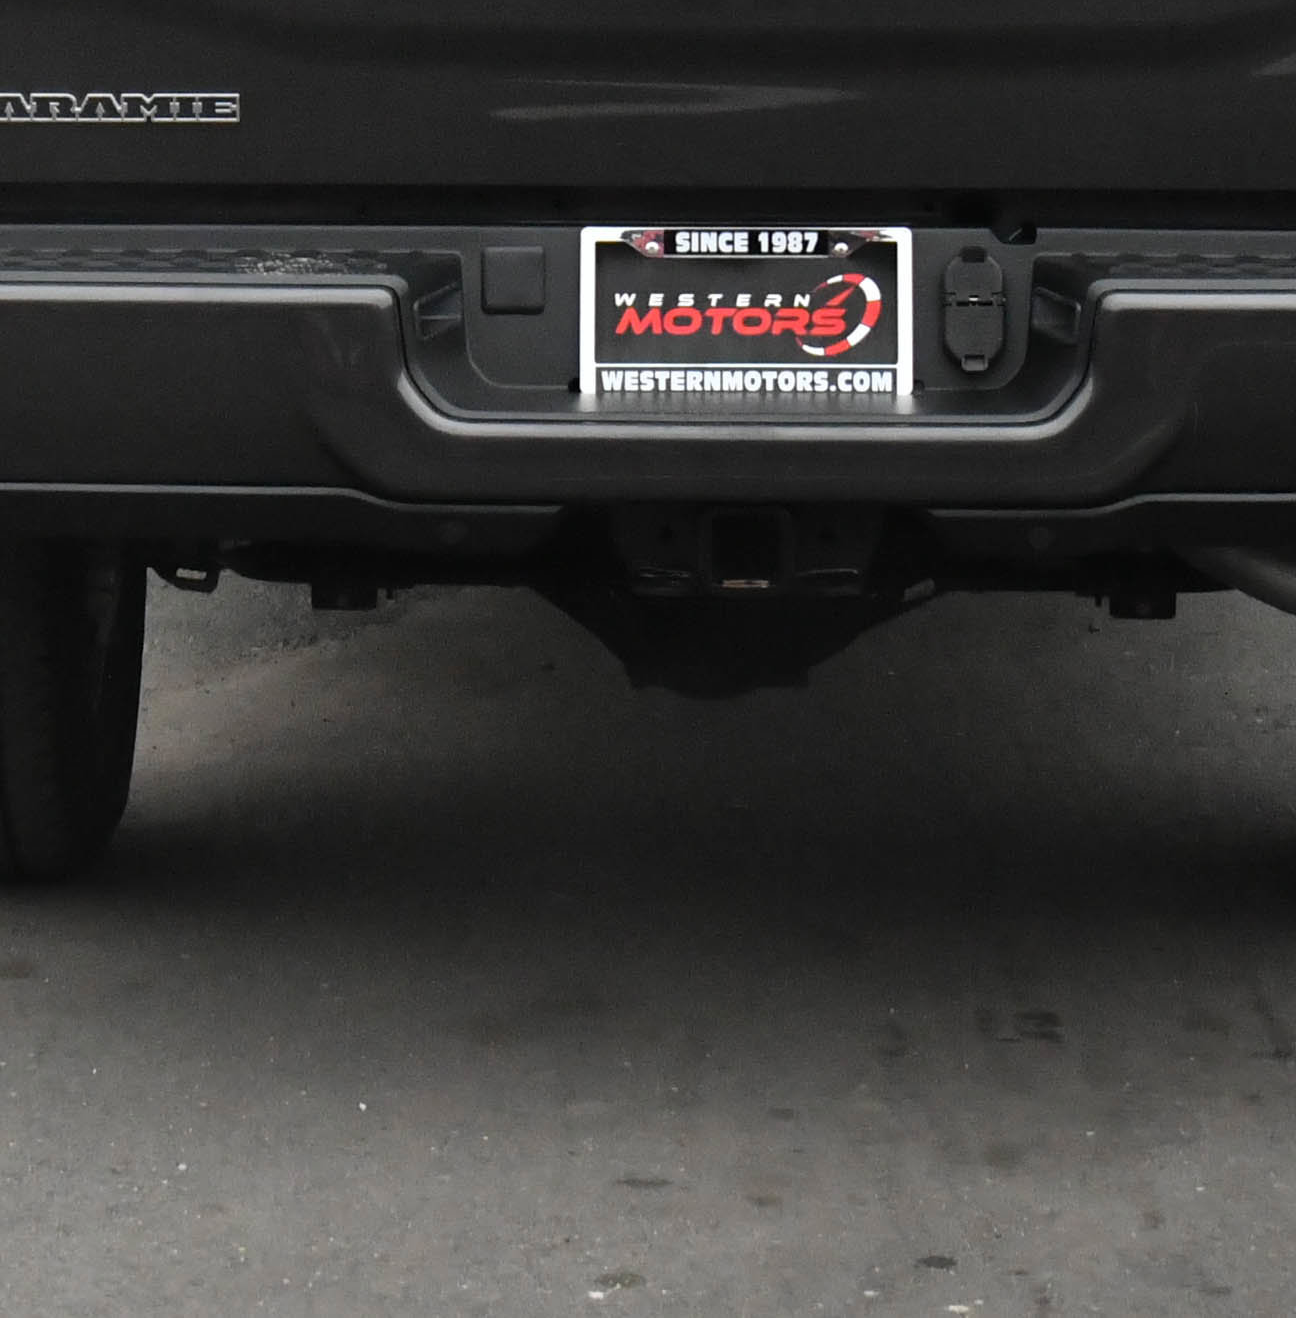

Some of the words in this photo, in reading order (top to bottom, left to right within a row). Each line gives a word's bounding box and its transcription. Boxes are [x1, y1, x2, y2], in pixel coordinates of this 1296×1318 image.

[675, 232, 749, 253] SINCE
[758, 232, 819, 252] 1987
[614, 293, 811, 307] WESTERN
[615, 308, 846, 335] MOTORS
[601, 370, 892, 392] WESTERNMOTORS.COM
